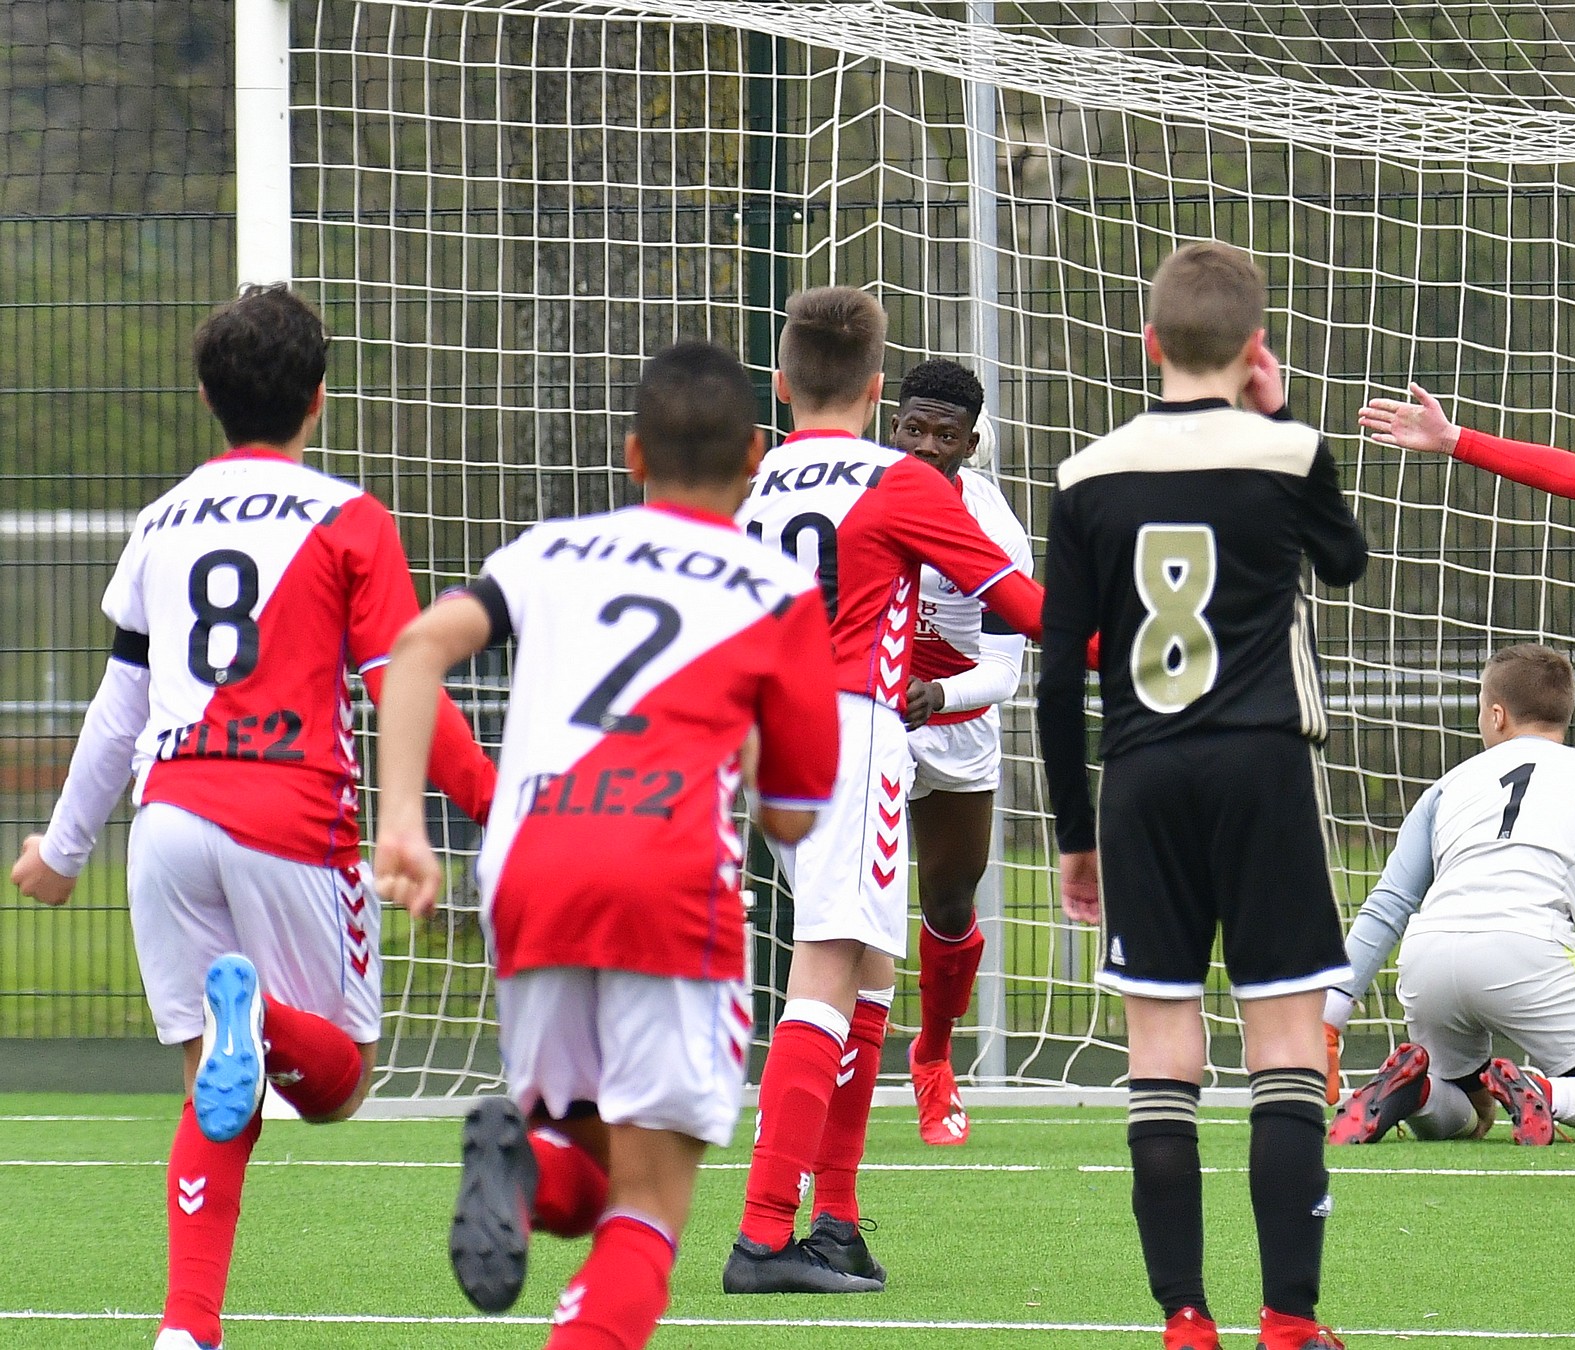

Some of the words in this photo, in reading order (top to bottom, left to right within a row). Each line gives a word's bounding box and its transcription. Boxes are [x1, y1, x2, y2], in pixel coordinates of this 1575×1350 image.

[749, 461, 888, 497] KOKI
[188, 548, 260, 688] 8
[747, 511, 839, 625] 0
[1130, 522, 1219, 714] 8
[568, 593, 683, 737] 2
[1497, 762, 1537, 840] 1
